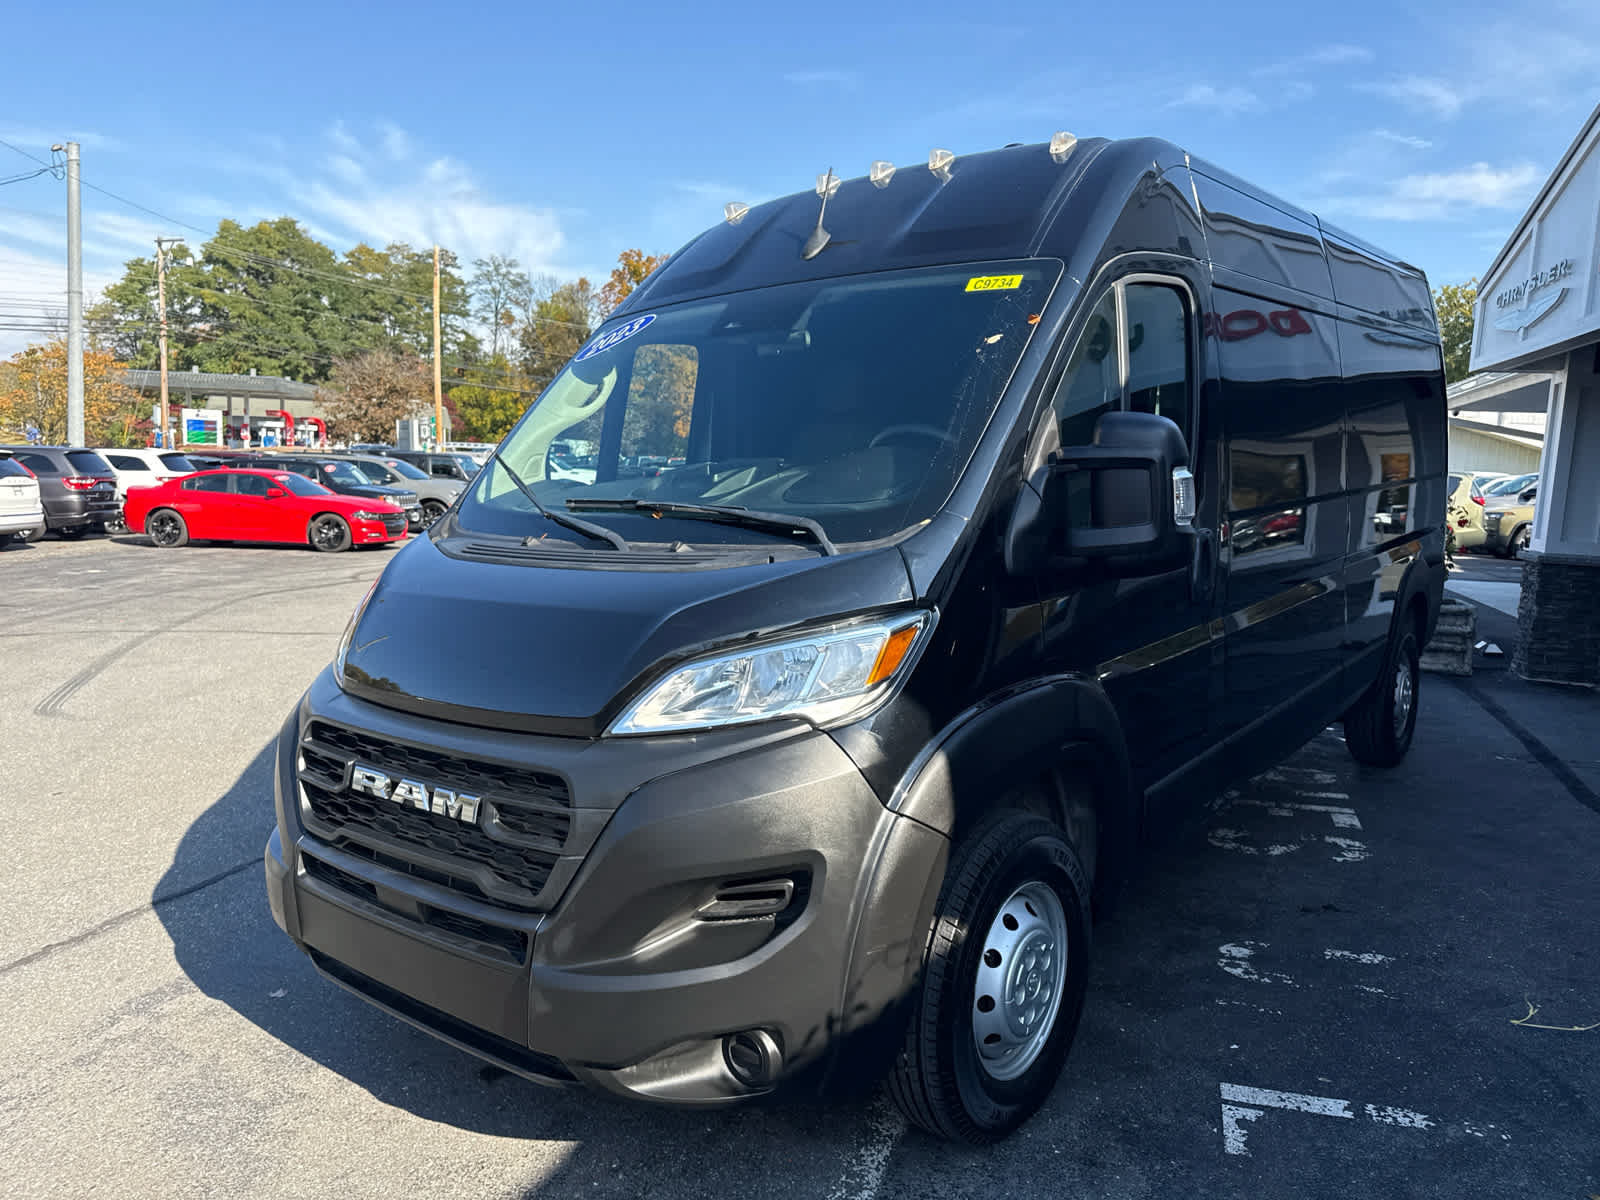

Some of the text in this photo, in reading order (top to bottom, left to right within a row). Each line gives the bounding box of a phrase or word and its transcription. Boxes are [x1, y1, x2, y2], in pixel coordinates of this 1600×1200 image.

[974, 278, 1015, 289] C9734
[1496, 259, 1569, 308] CHRYSLER
[584, 318, 646, 358] 2023
[351, 765, 481, 824] RAM
